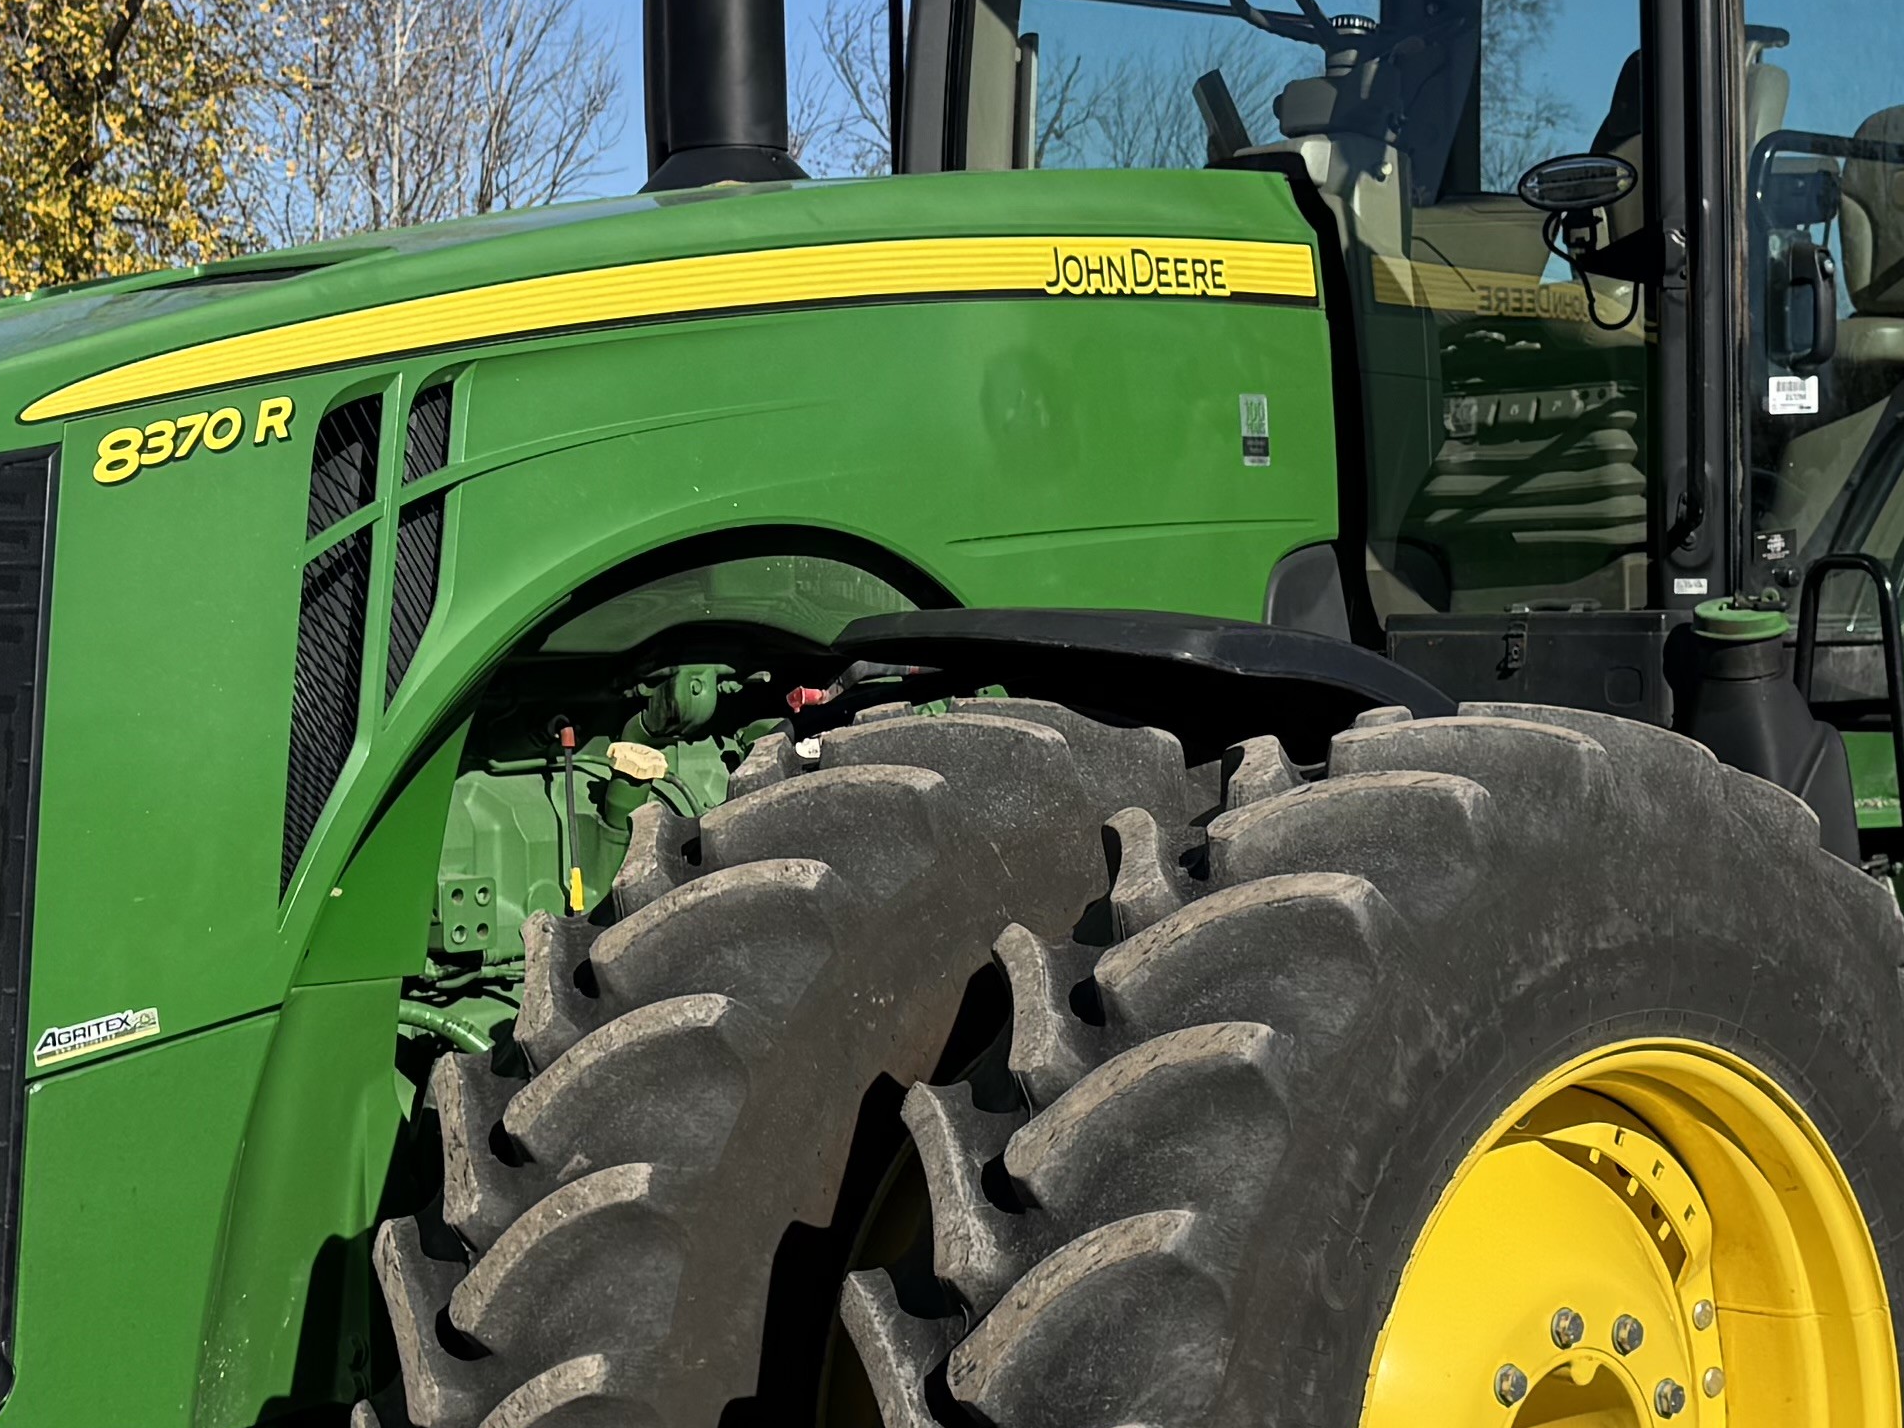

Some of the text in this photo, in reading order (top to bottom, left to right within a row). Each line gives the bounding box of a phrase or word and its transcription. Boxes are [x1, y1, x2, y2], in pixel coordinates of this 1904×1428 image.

[92, 395, 295, 486] 8370 R
[37, 1013, 132, 1052] AGRITEX
